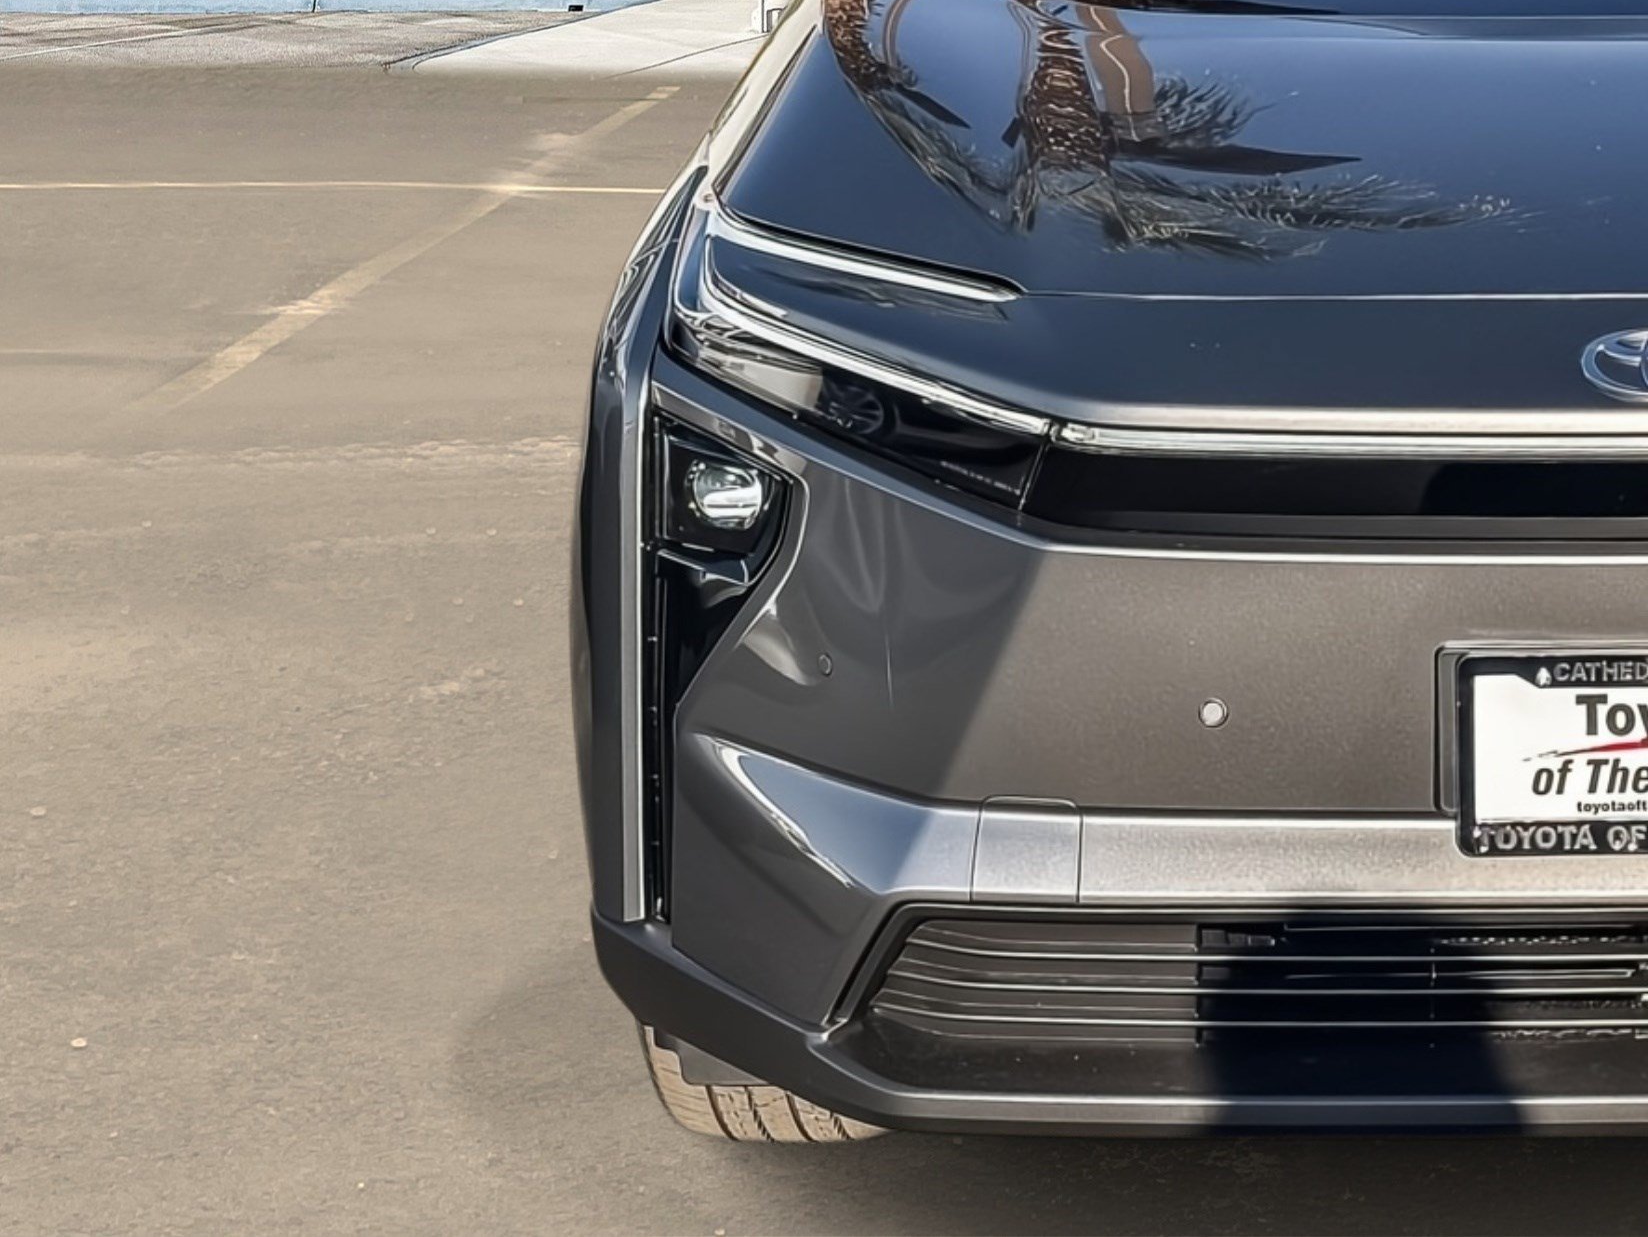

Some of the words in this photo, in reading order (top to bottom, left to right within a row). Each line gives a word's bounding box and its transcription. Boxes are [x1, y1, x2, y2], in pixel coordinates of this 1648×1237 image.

[1530, 760, 1573, 796] of
[1474, 825, 1597, 853] TOYOTA
[1606, 825, 1648, 852] OF
